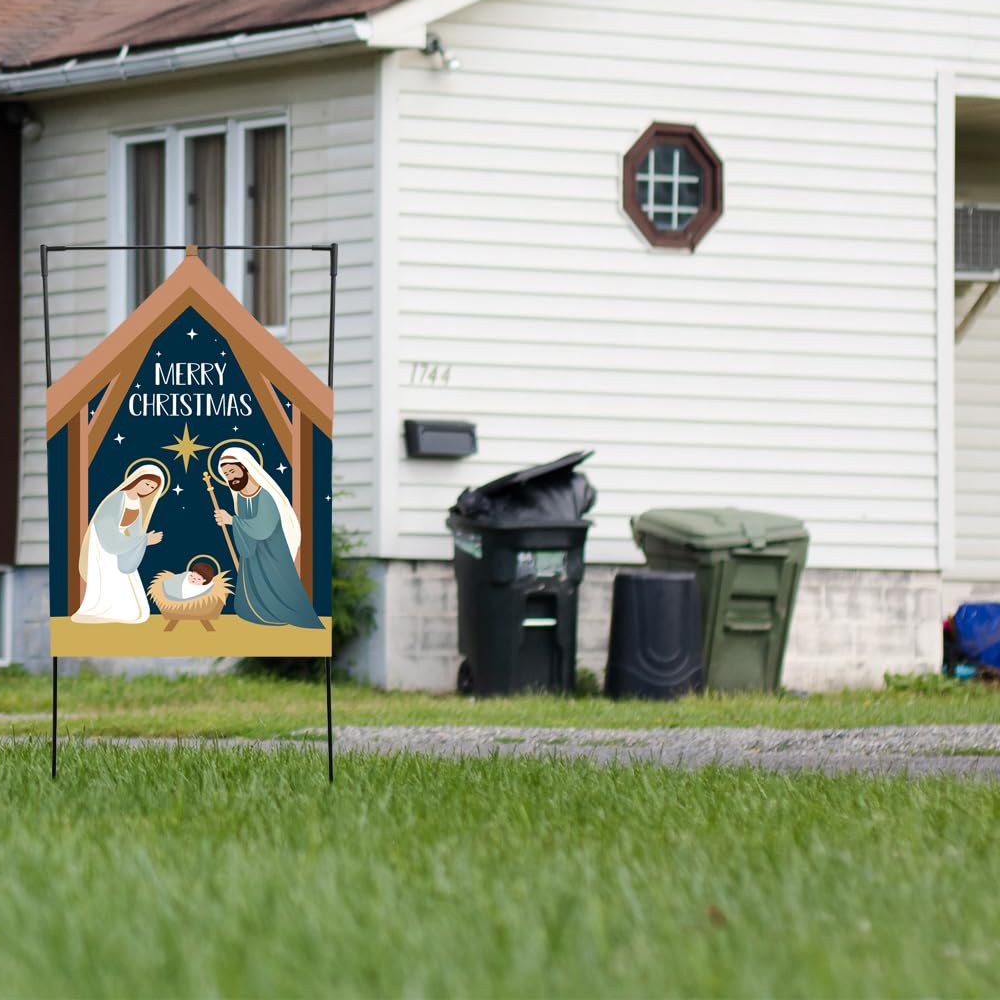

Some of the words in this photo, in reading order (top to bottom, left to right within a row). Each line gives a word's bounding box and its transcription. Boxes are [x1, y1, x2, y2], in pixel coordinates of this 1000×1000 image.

[155, 362, 227, 386] MERRY
[409, 361, 452, 386] 1744
[128, 393, 253, 417] CHRISTMAS
